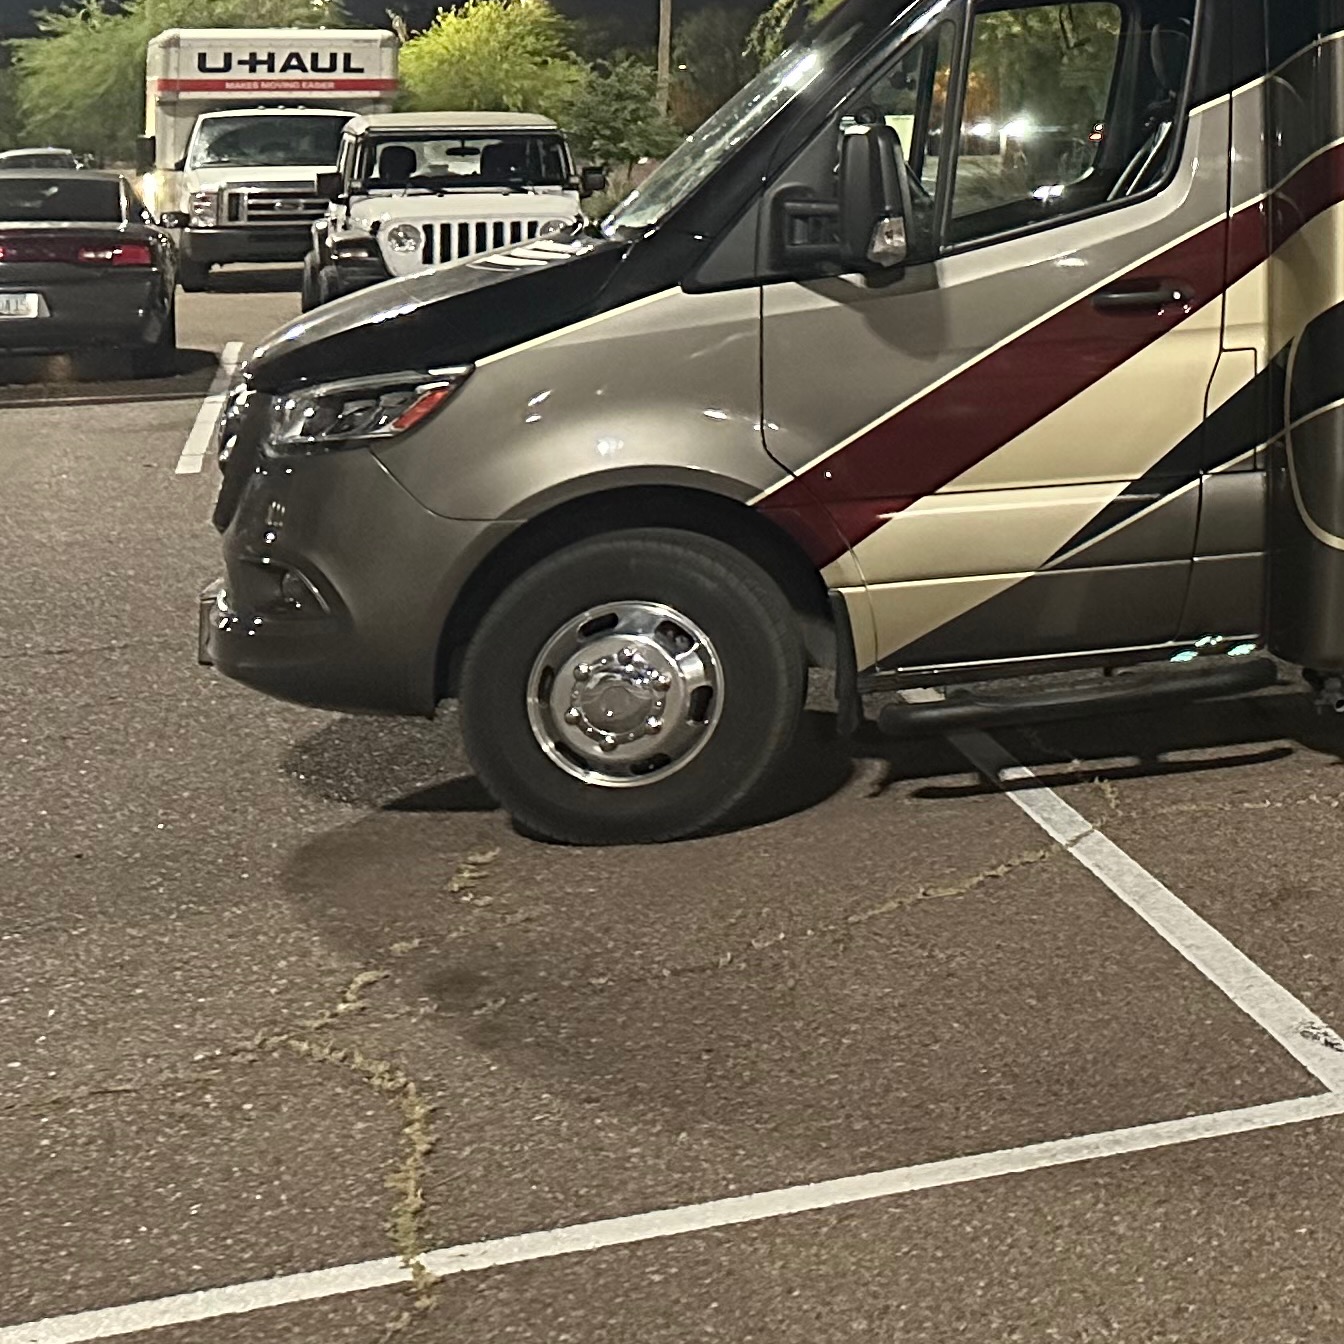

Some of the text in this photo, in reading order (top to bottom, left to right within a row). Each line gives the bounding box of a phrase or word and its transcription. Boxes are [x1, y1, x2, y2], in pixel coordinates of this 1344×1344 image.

[197, 52, 364, 74] U-HAUL
[225, 81, 335, 90] MAKES MOVING EASIER
